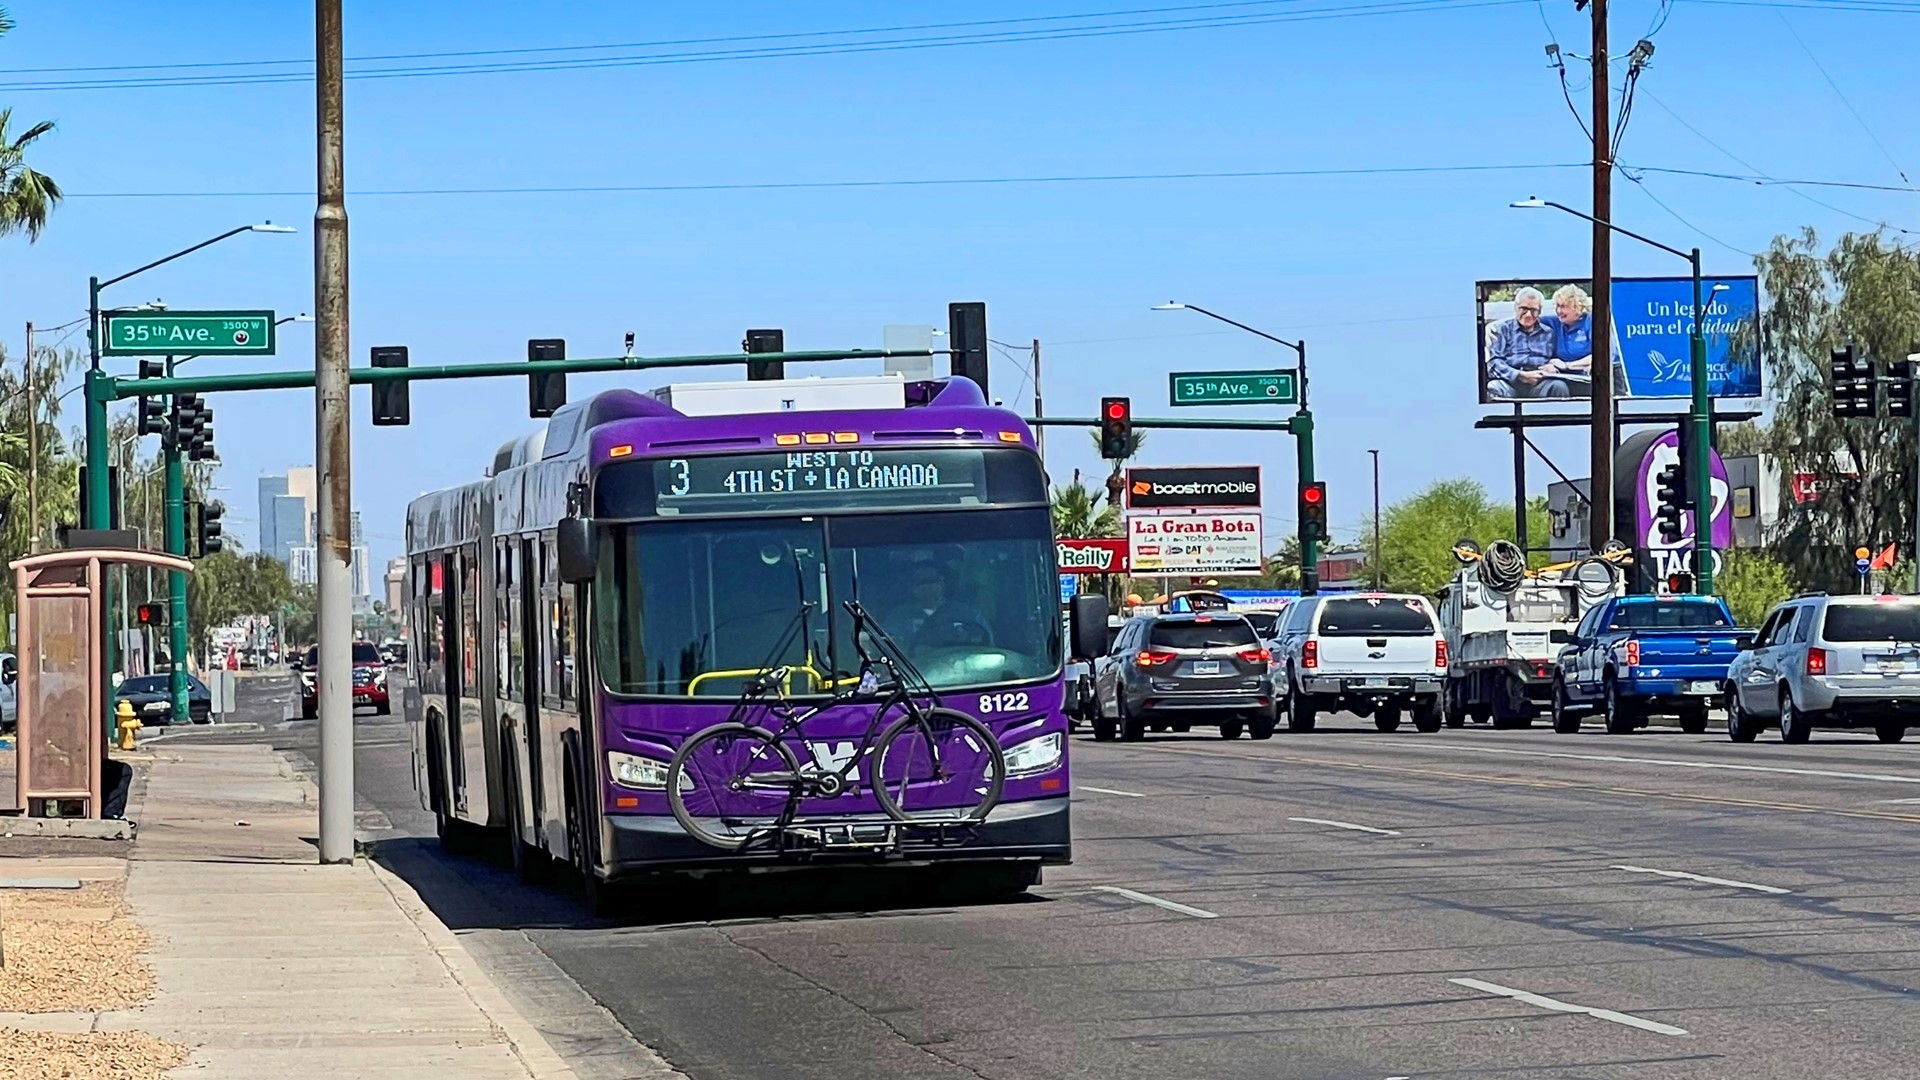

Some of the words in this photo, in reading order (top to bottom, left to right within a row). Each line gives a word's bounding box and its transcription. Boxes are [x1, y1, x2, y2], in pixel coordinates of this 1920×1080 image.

[1647, 301, 1670, 317] Un
[1675, 300, 1728, 319] legdo
[123, 324, 166, 342] 35th
[169, 325, 215, 341] Ave.
[222, 321, 249, 330] 3500
[250, 321, 260, 329] W
[1626, 322, 1663, 339] para
[1667, 319, 1681, 335] el
[1185, 382, 1217, 396] 35th
[1219, 382, 1254, 395] Ave.
[786, 451, 839, 469] WEST
[847, 450, 873, 466] TO
[669, 458, 690, 496] 3
[723, 470, 764, 493] 4TH
[770, 469, 796, 492] ST
[824, 466, 850, 490] LA
[856, 463, 939, 489] CANADA
[1135, 521, 1158, 534] La
[1162, 519, 1207, 533] Gran
[1211, 519, 1255, 533] Bota
[1059, 545, 1110, 567] 'Reilly
[1185, 545, 1202, 555] CAT
[979, 692, 1030, 714] 8122
